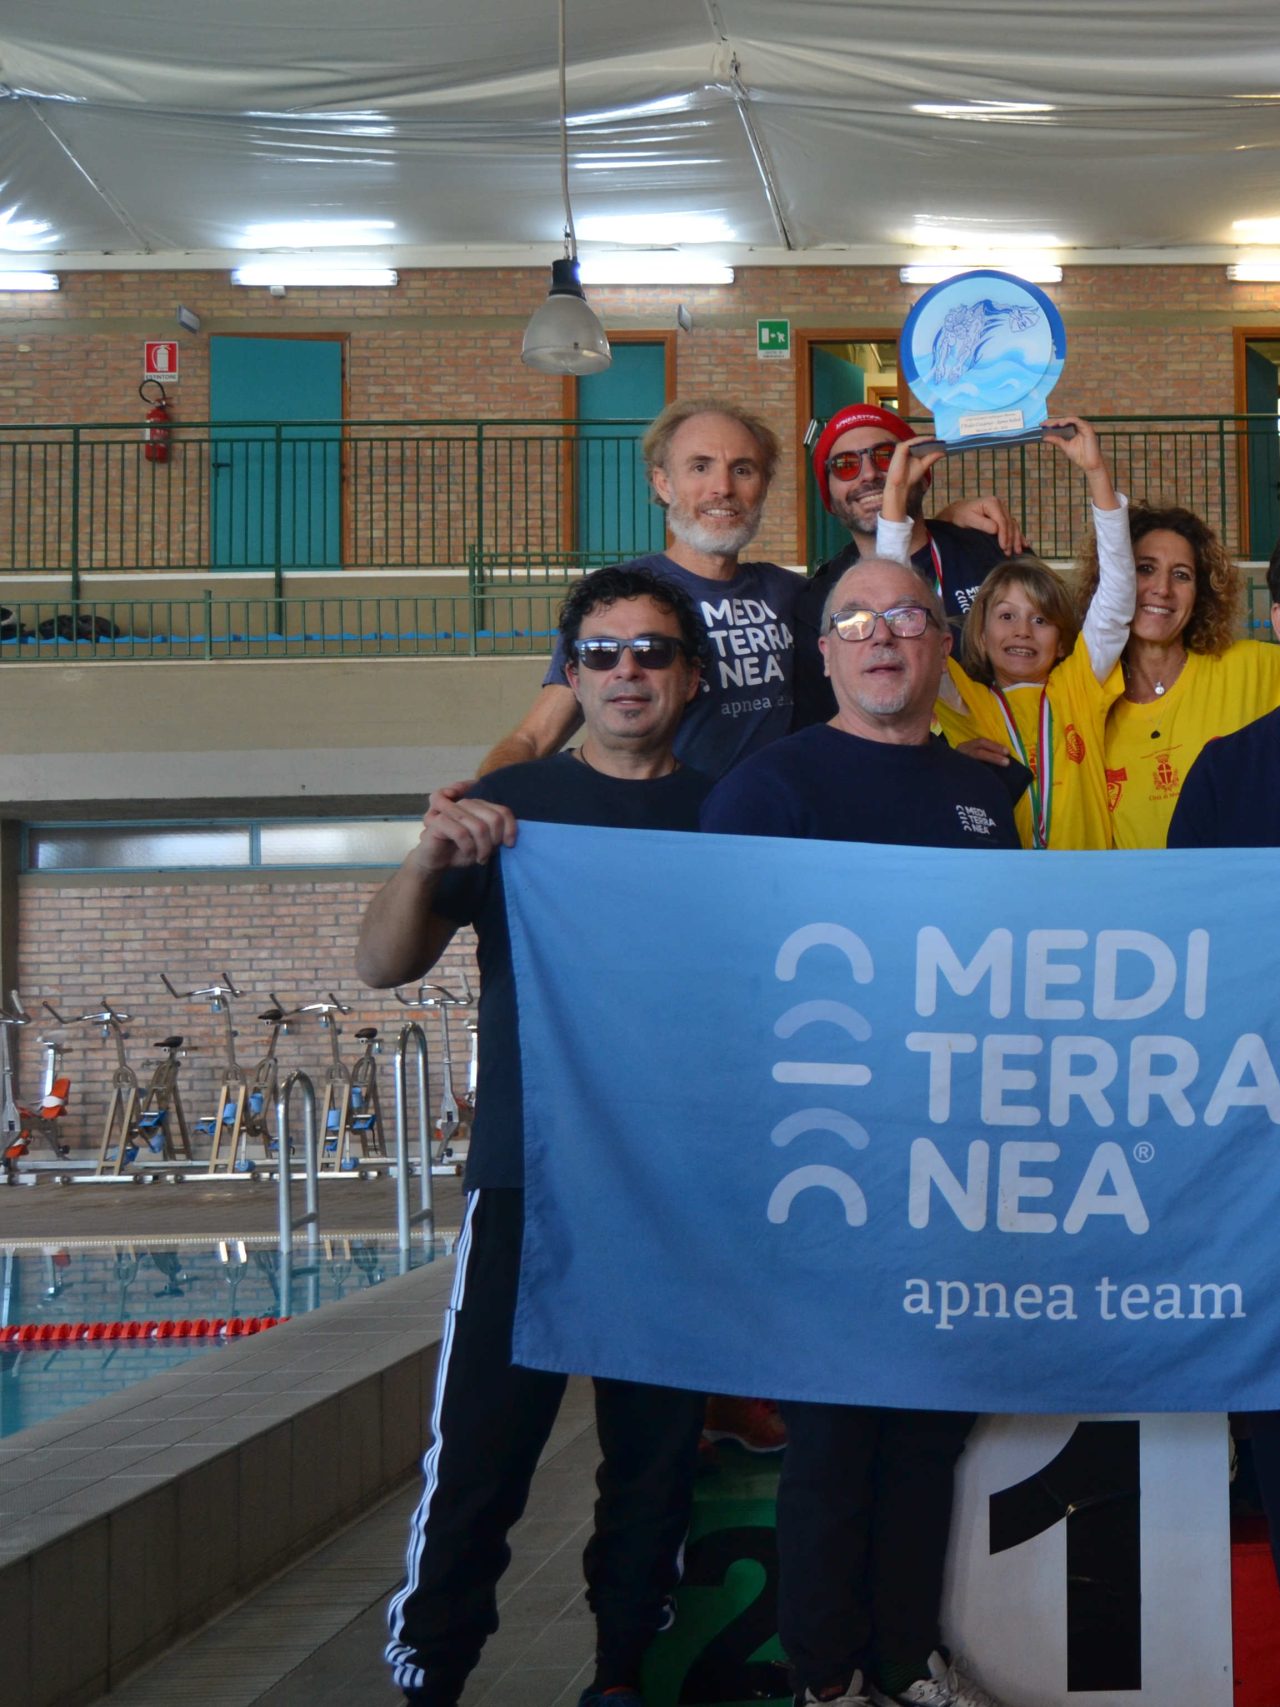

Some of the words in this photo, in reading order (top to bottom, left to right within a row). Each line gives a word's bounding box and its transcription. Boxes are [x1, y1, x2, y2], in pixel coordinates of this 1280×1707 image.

[700, 598, 778, 628] MEDI
[707, 622, 795, 658] TERRA
[718, 654, 785, 689] NEA
[721, 697, 773, 718] apnea
[964, 805, 987, 818] MEDI
[967, 814, 997, 827] TERRA
[914, 925, 1210, 1019] MEDI
[902, 1277, 1078, 1330] apnea
[1095, 1276, 1247, 1321] team
[989, 1420, 1142, 1692] 1
